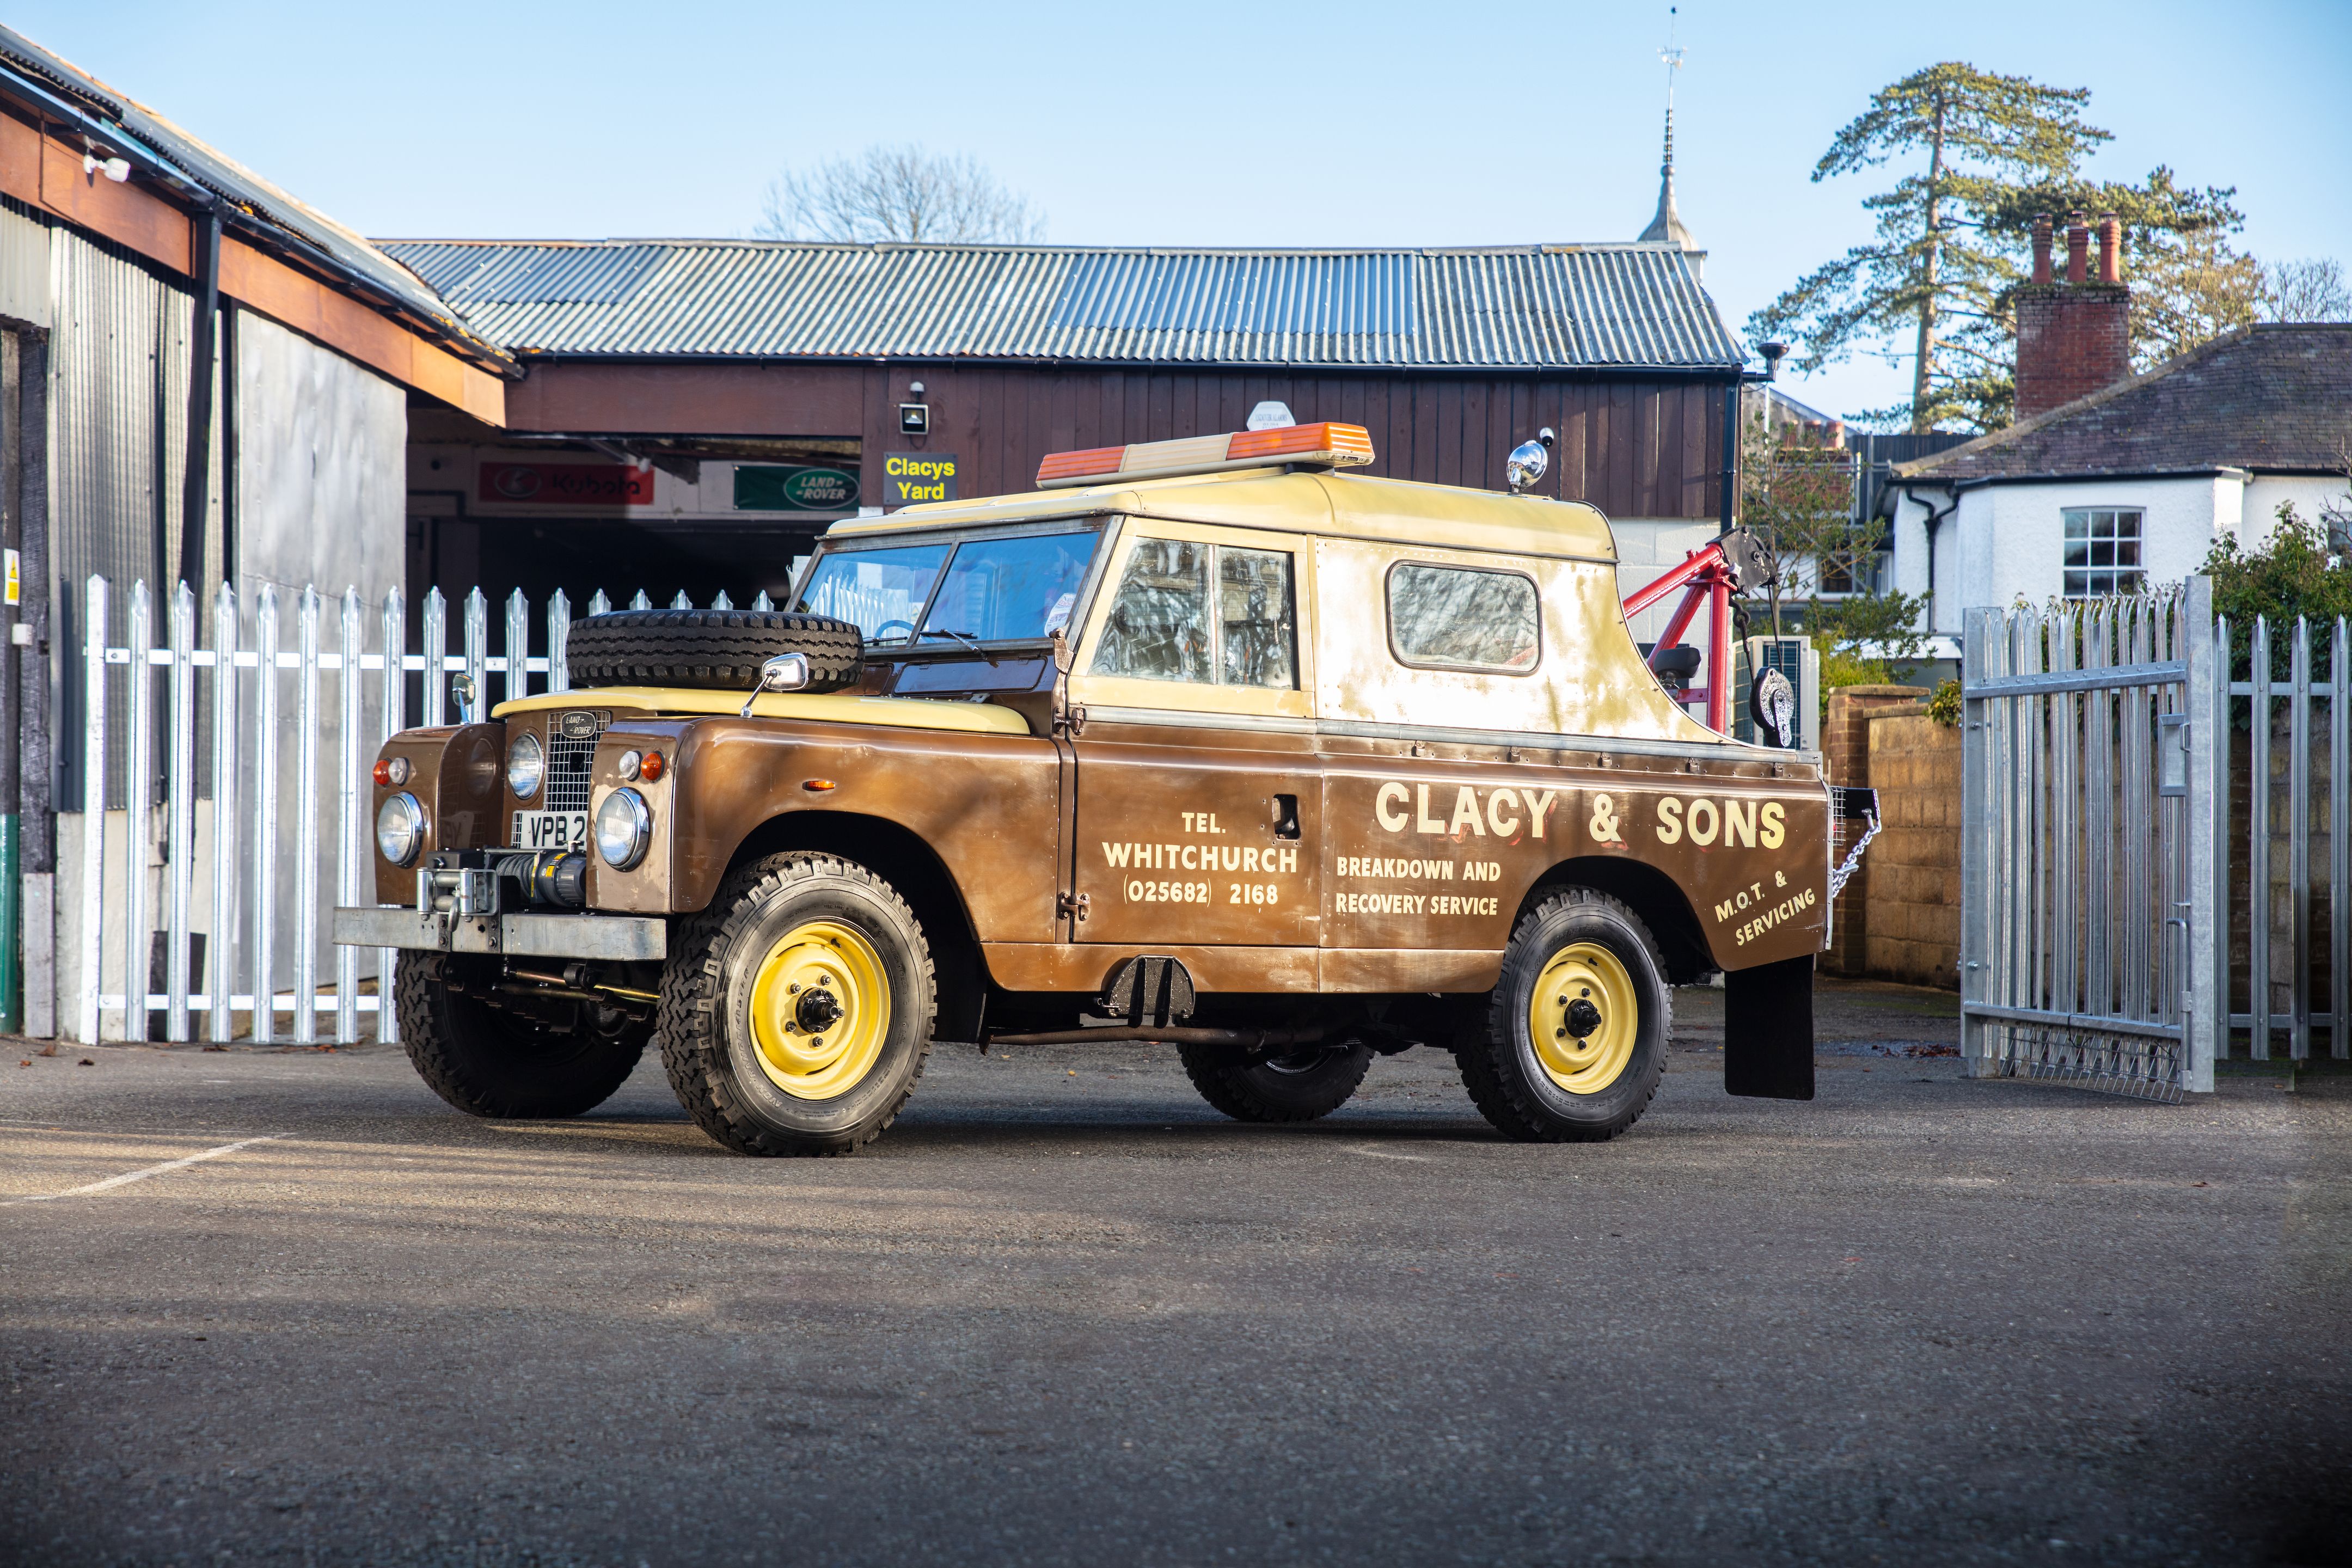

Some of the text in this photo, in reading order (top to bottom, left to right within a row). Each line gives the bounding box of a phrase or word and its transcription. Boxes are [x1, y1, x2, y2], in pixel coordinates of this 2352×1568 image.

[886, 458, 955, 480] Clacys
[553, 474, 641, 495] Kubota
[898, 482, 944, 500] Yard
[566, 716, 580, 724] LAND
[1181, 812, 1226, 834] TEL.
[1376, 782, 1785, 849] CLACY & SONS
[531, 816, 567, 847] VPB
[1102, 842, 1297, 873] WHITCHURCH
[1337, 856, 1501, 882] BREAKDOWN AND
[1124, 874, 1278, 908] (025682) 2168
[1336, 892, 1498, 916] RECOVERY SERVICE
[1714, 870, 1787, 923] M.O.T. &
[1735, 888, 1816, 946] SERVICING
[735, 966, 783, 1108] AVON RANGEMASTER
